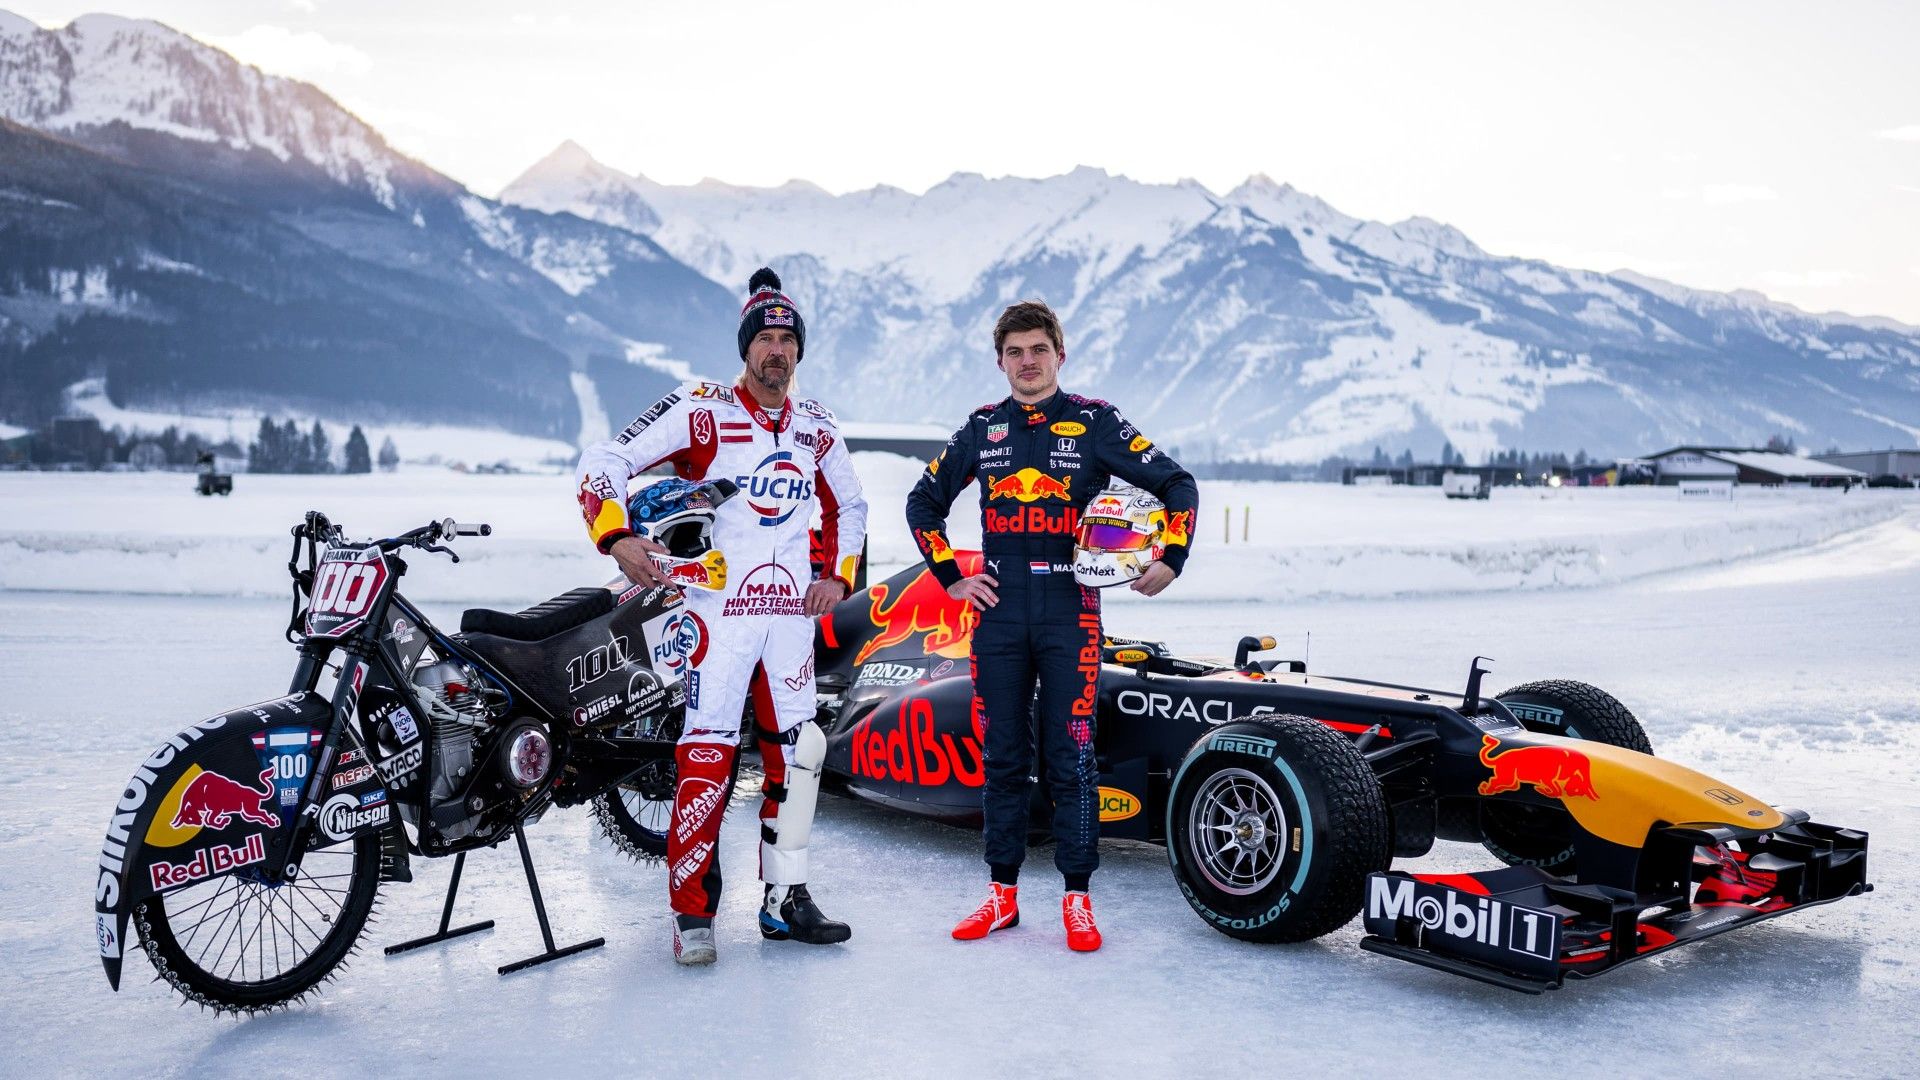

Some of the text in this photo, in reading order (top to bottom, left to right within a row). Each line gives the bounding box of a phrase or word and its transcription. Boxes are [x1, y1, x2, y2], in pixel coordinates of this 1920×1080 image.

[1059, 424, 1082, 433] RAUCH
[980, 447, 1003, 459] Mobil
[980, 460, 1011, 470] ORACLE
[1058, 459, 1081, 469] Tezos
[735, 475, 812, 502] FUCHS
[985, 506, 1078, 535] Red Bull
[1090, 505, 1124, 517] Red Bull
[1095, 517, 1108, 525] YOU
[1108, 519, 1128, 528] WINGS
[325, 549, 363, 562] FRANKY
[1152, 544, 1165, 560] Re
[1076, 563, 1116, 576] CarNext
[746, 583, 792, 597] MAN
[722, 608, 745, 617] BAD
[653, 636, 682, 663] FUC
[566, 635, 629, 693] 100
[859, 662, 926, 681] HONDA
[1072, 613, 1100, 716] Red Bull
[625, 689, 666, 715] HINTSTEINER
[630, 682, 656, 702] MAN
[689, 673, 698, 707] SKF
[587, 693, 623, 719] MIESL
[1501, 701, 1564, 726] RELLI
[395, 715, 412, 729] FUCHS
[851, 694, 986, 787] Red Bu
[1208, 733, 1278, 759] PIRELLI
[269, 753, 307, 780] 100
[380, 748, 421, 780] WACO
[363, 791, 384, 804] SKF
[680, 786, 716, 820] MAN
[1099, 797, 1130, 812] UCH
[335, 803, 390, 833] Nilsson
[679, 828, 693, 844] BAD
[151, 833, 266, 891] Red Bull
[1181, 881, 1290, 930] SOTTOZERO
[1369, 877, 1501, 946] Mobil
